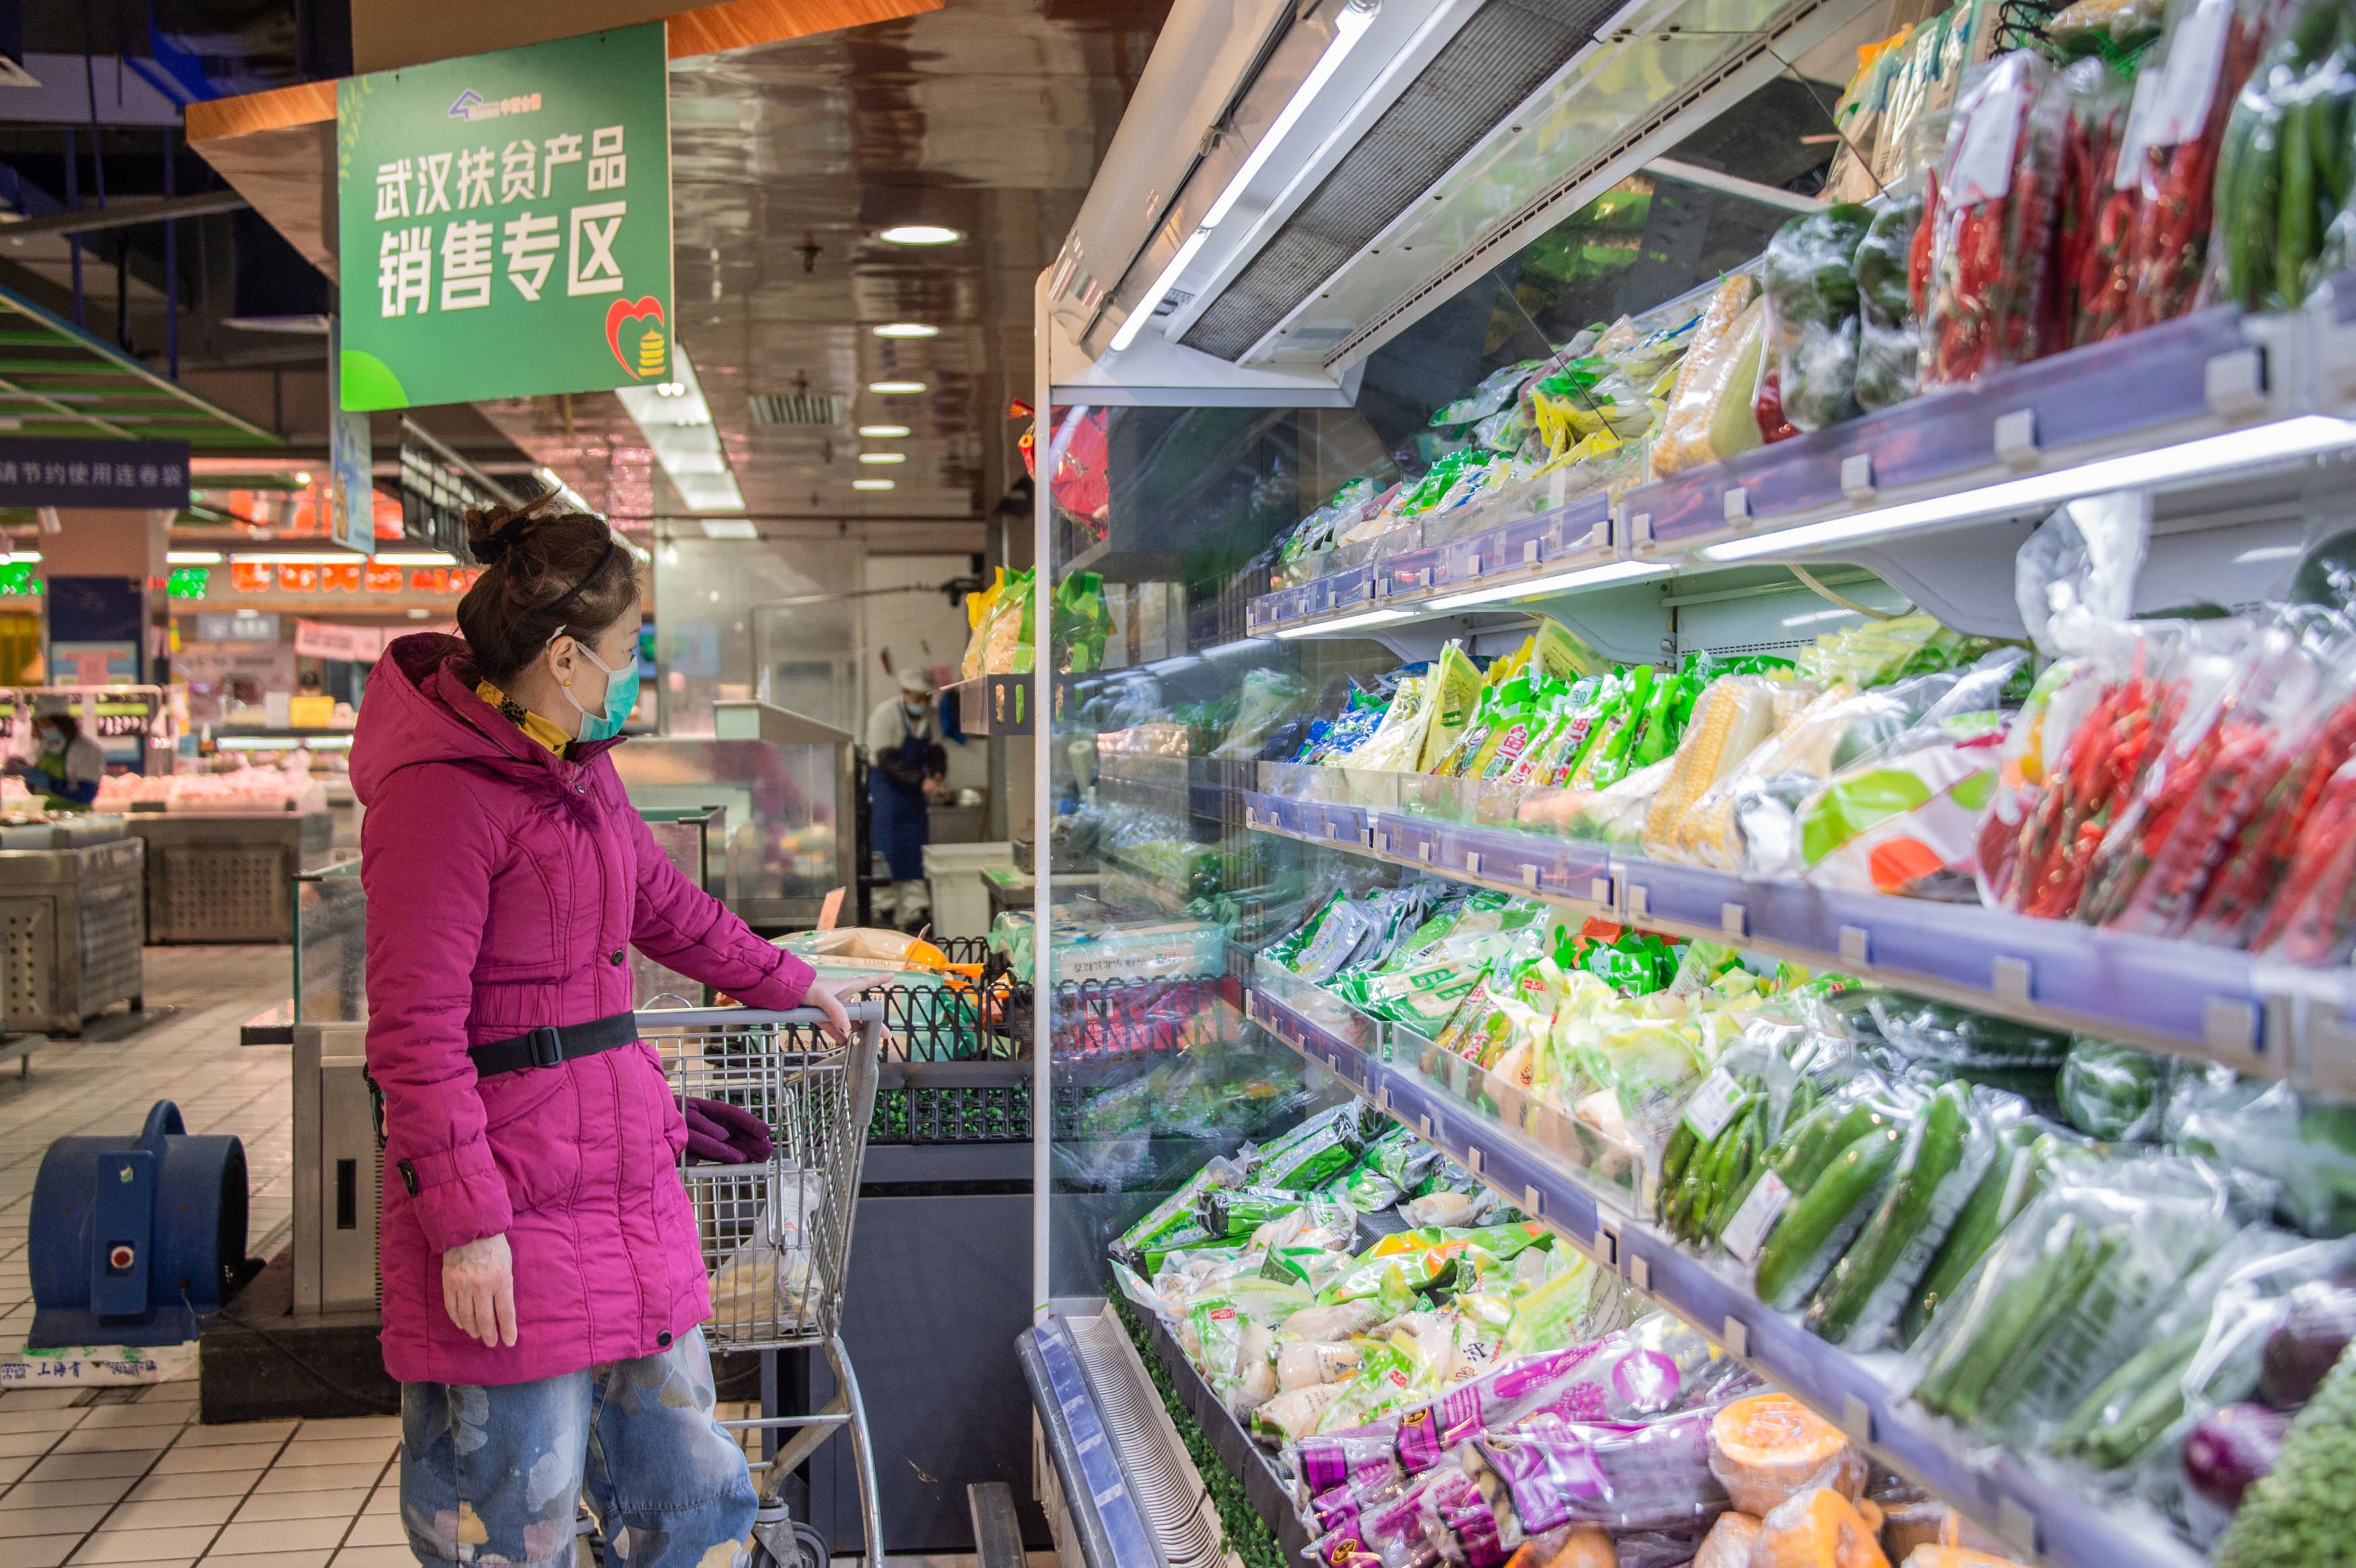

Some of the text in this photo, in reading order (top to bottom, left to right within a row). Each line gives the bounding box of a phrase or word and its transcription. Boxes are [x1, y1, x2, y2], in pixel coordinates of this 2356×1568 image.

[374, 125, 627, 221] 武汉扶贫产品
[378, 201, 627, 318] 销售专区
